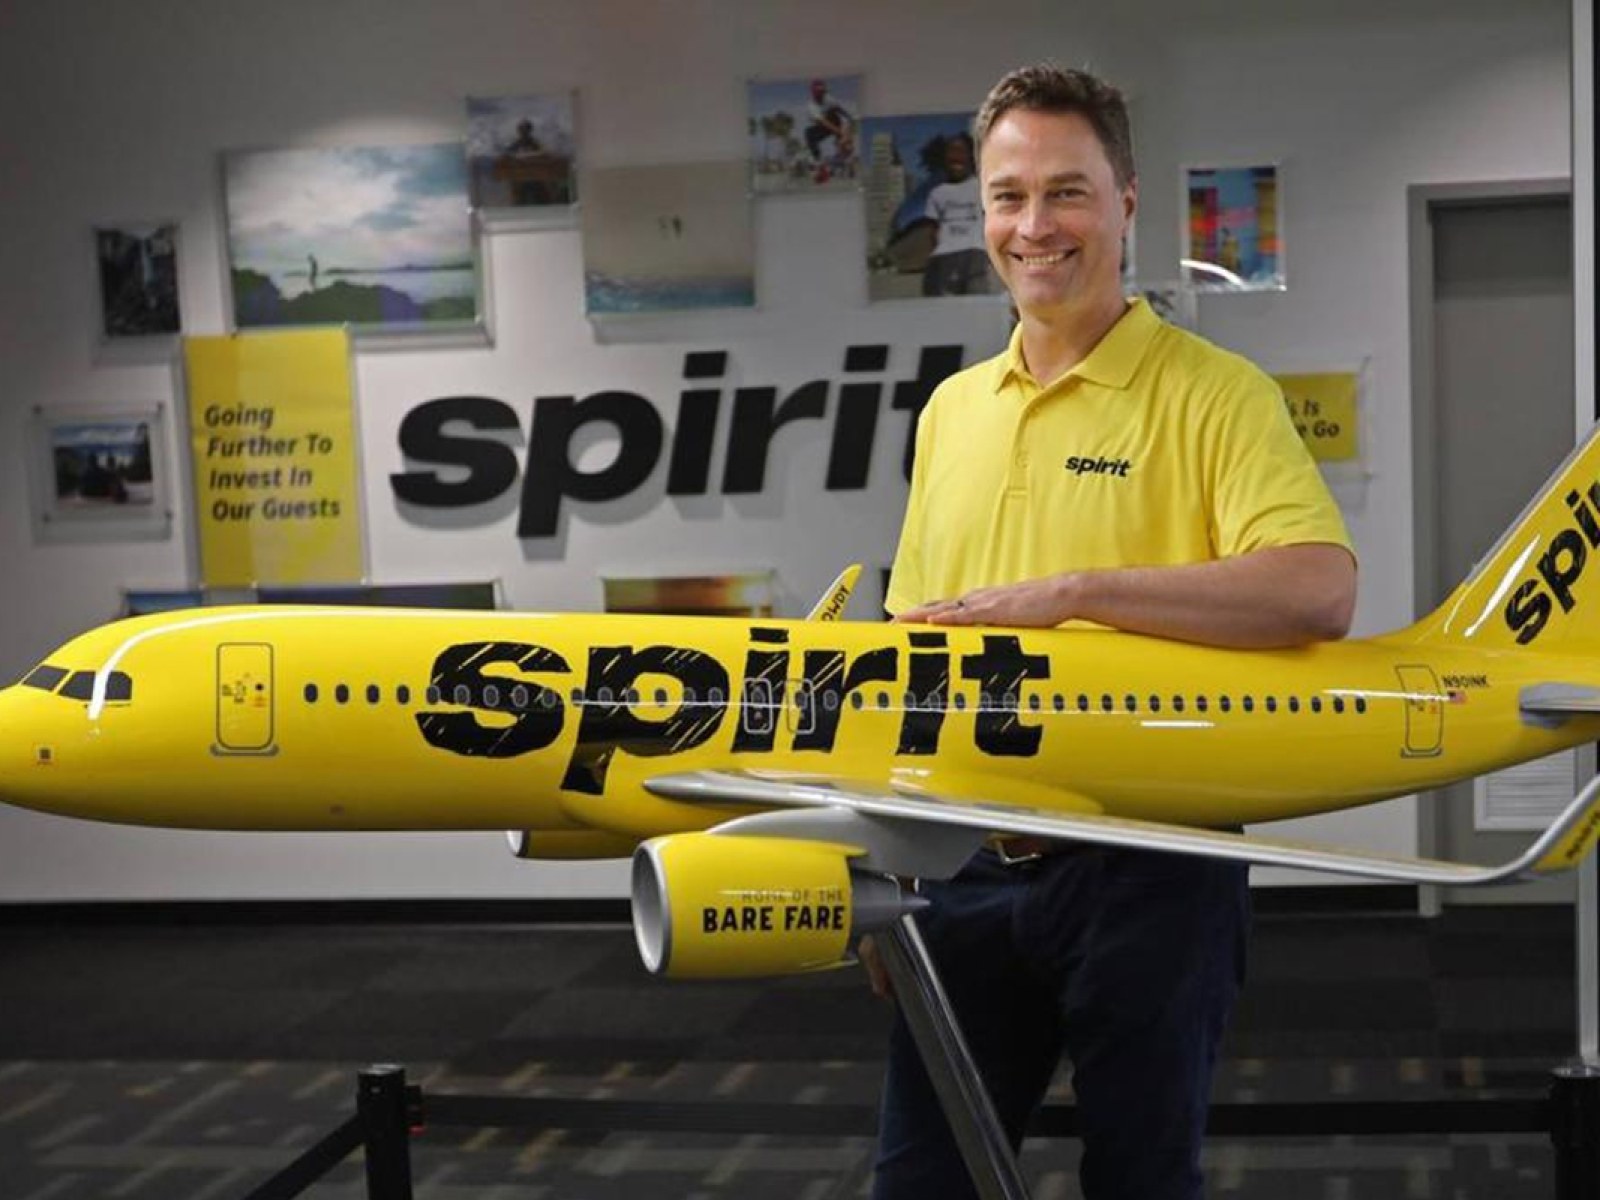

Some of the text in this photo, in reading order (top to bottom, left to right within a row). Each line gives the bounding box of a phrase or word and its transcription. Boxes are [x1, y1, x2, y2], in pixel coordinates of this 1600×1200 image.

[204, 402, 274, 430] Going
[1313, 419, 1340, 438] Go
[207, 432, 333, 458] Further To
[209, 465, 313, 490] Invest In
[1065, 456, 1131, 477] spirit
[212, 497, 340, 522] Our Guests
[415, 627, 1051, 795] spirit
[702, 905, 845, 933] BARE FARE
